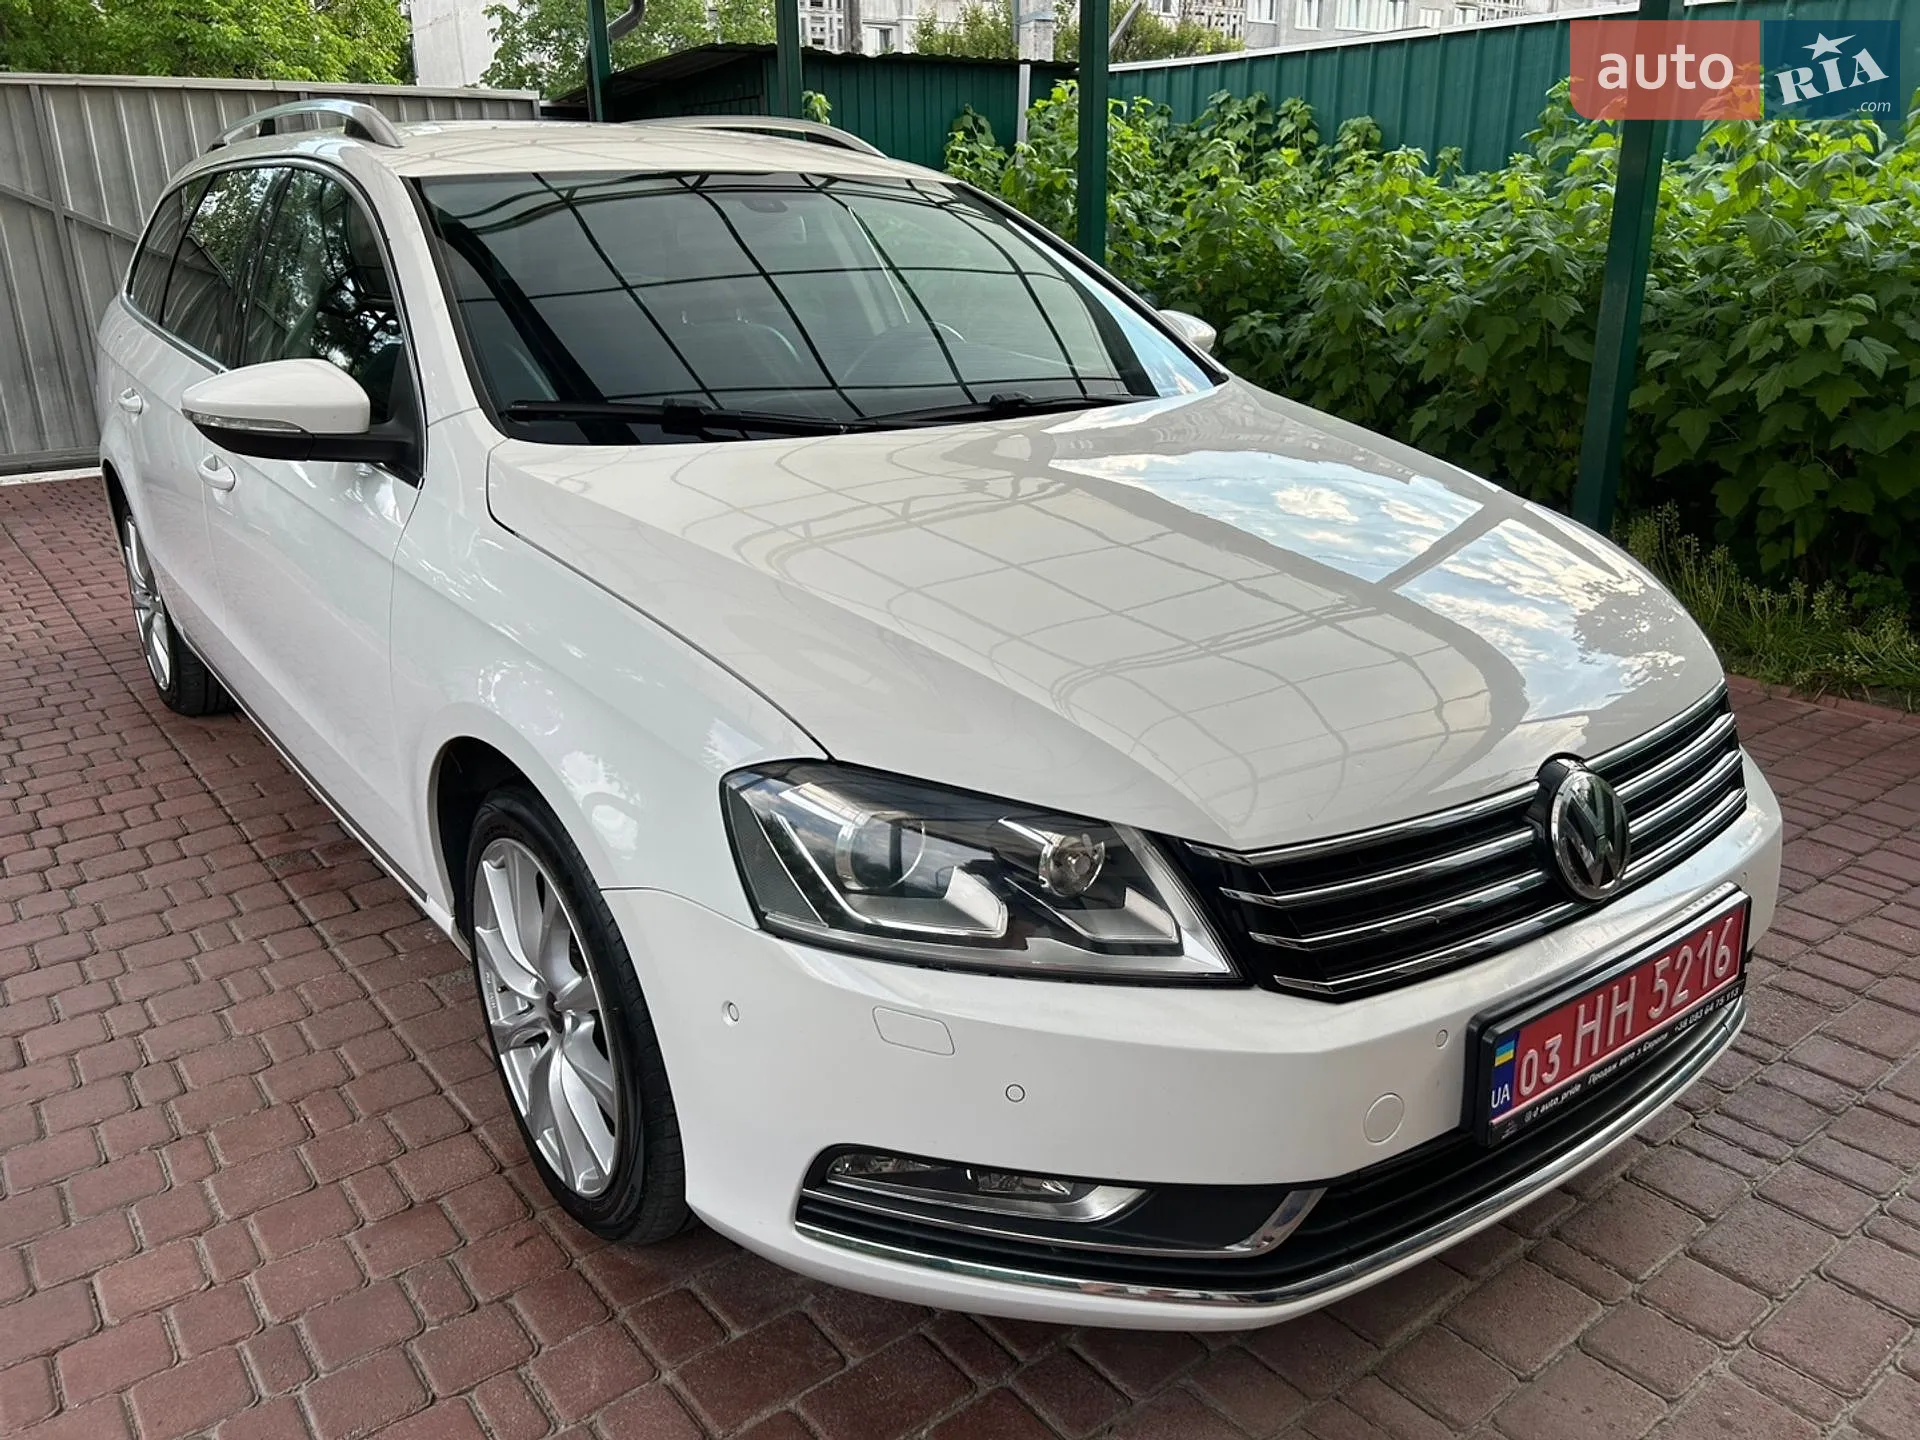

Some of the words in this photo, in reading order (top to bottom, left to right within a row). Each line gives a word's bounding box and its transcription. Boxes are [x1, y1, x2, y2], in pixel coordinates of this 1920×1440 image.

[1519, 1033, 1563, 1097] 03
[1573, 975, 1637, 1067] HH
[1648, 917, 1734, 1020] 5216
[1490, 1083, 1511, 1109] UA
